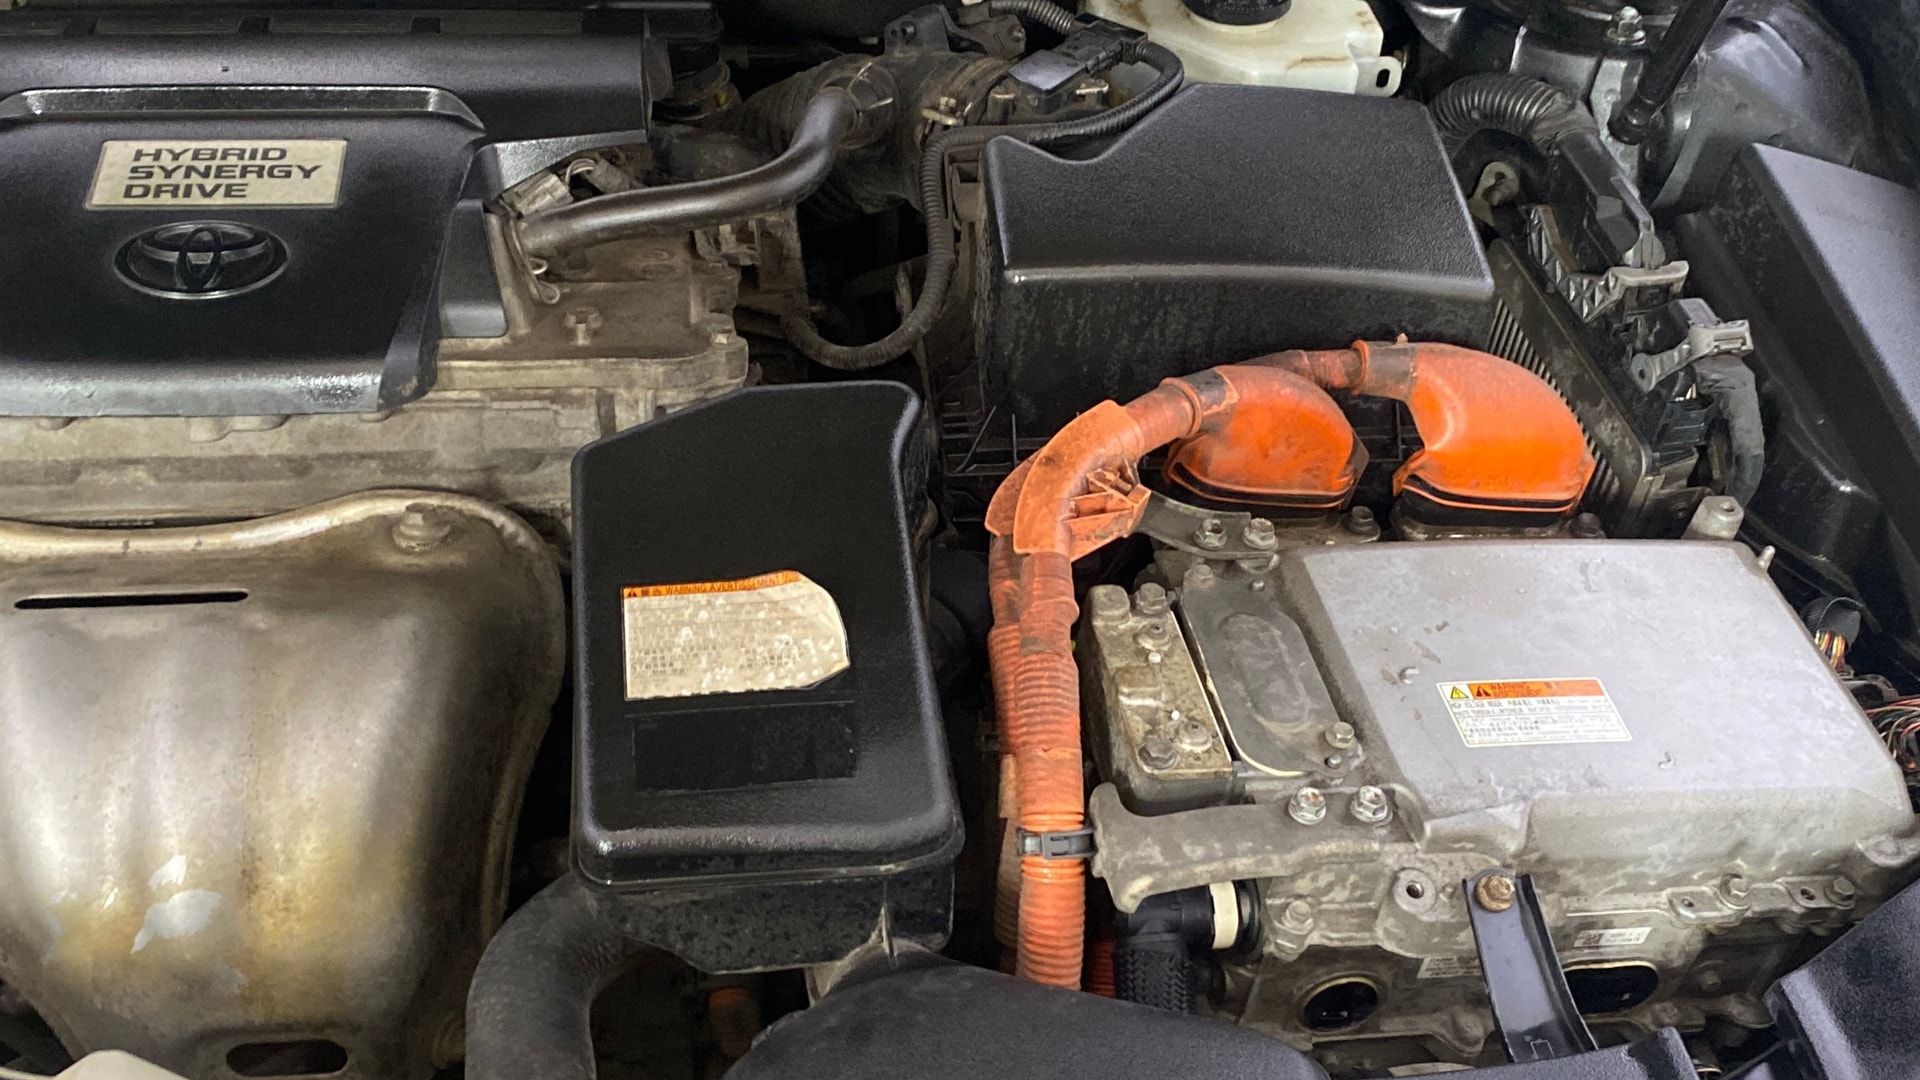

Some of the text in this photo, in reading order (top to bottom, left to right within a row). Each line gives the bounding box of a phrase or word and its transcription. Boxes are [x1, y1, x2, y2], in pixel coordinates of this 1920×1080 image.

[132, 147, 287, 162] HYBRID
[127, 164, 323, 180] SYNERGY
[122, 182, 249, 199] DRIVE
[665, 582, 707, 596] WARNING
